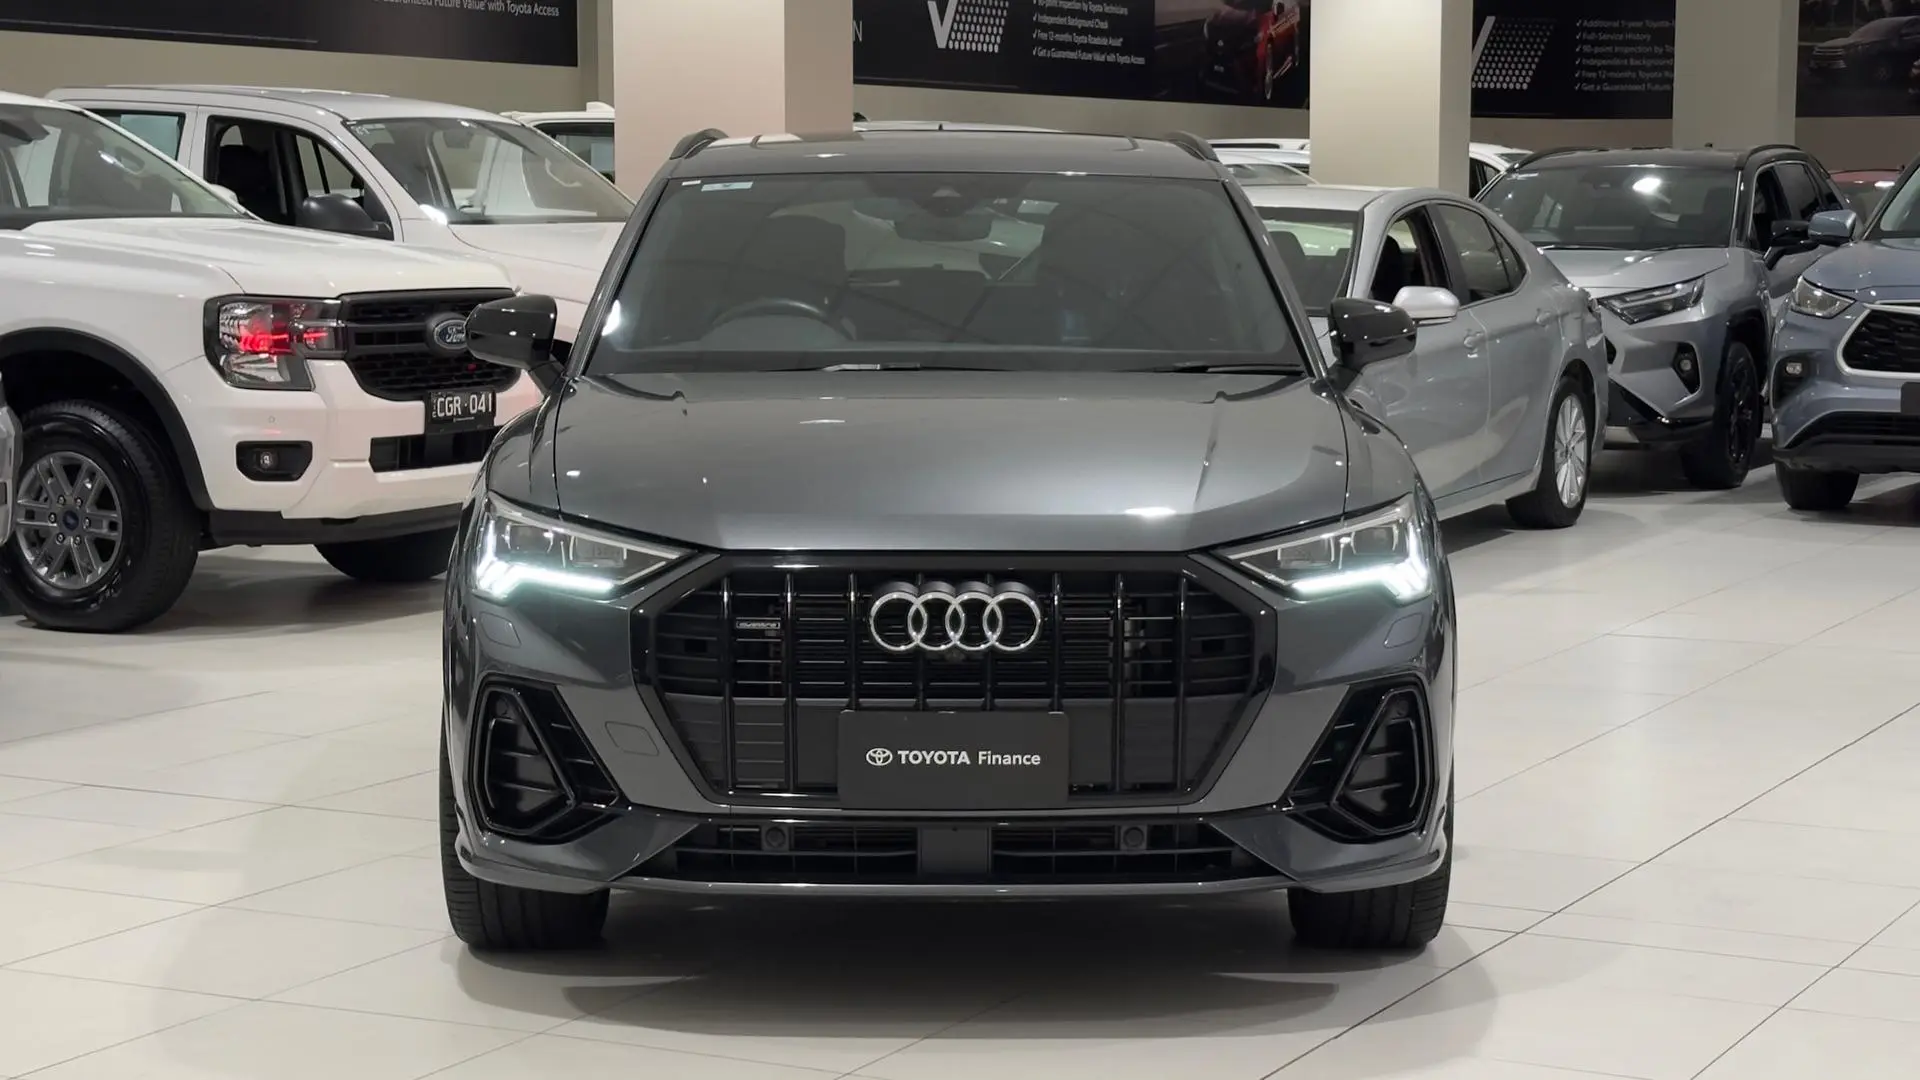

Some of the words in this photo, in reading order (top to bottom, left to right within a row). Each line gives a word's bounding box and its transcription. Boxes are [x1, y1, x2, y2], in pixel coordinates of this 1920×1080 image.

[487, 1, 505, 12] with
[506, 1, 532, 16] Toyota
[532, 3, 560, 17] Access
[1625, 32, 1652, 42] History
[897, 750, 971, 765] TOYOTA
[978, 751, 1041, 765] Finance
